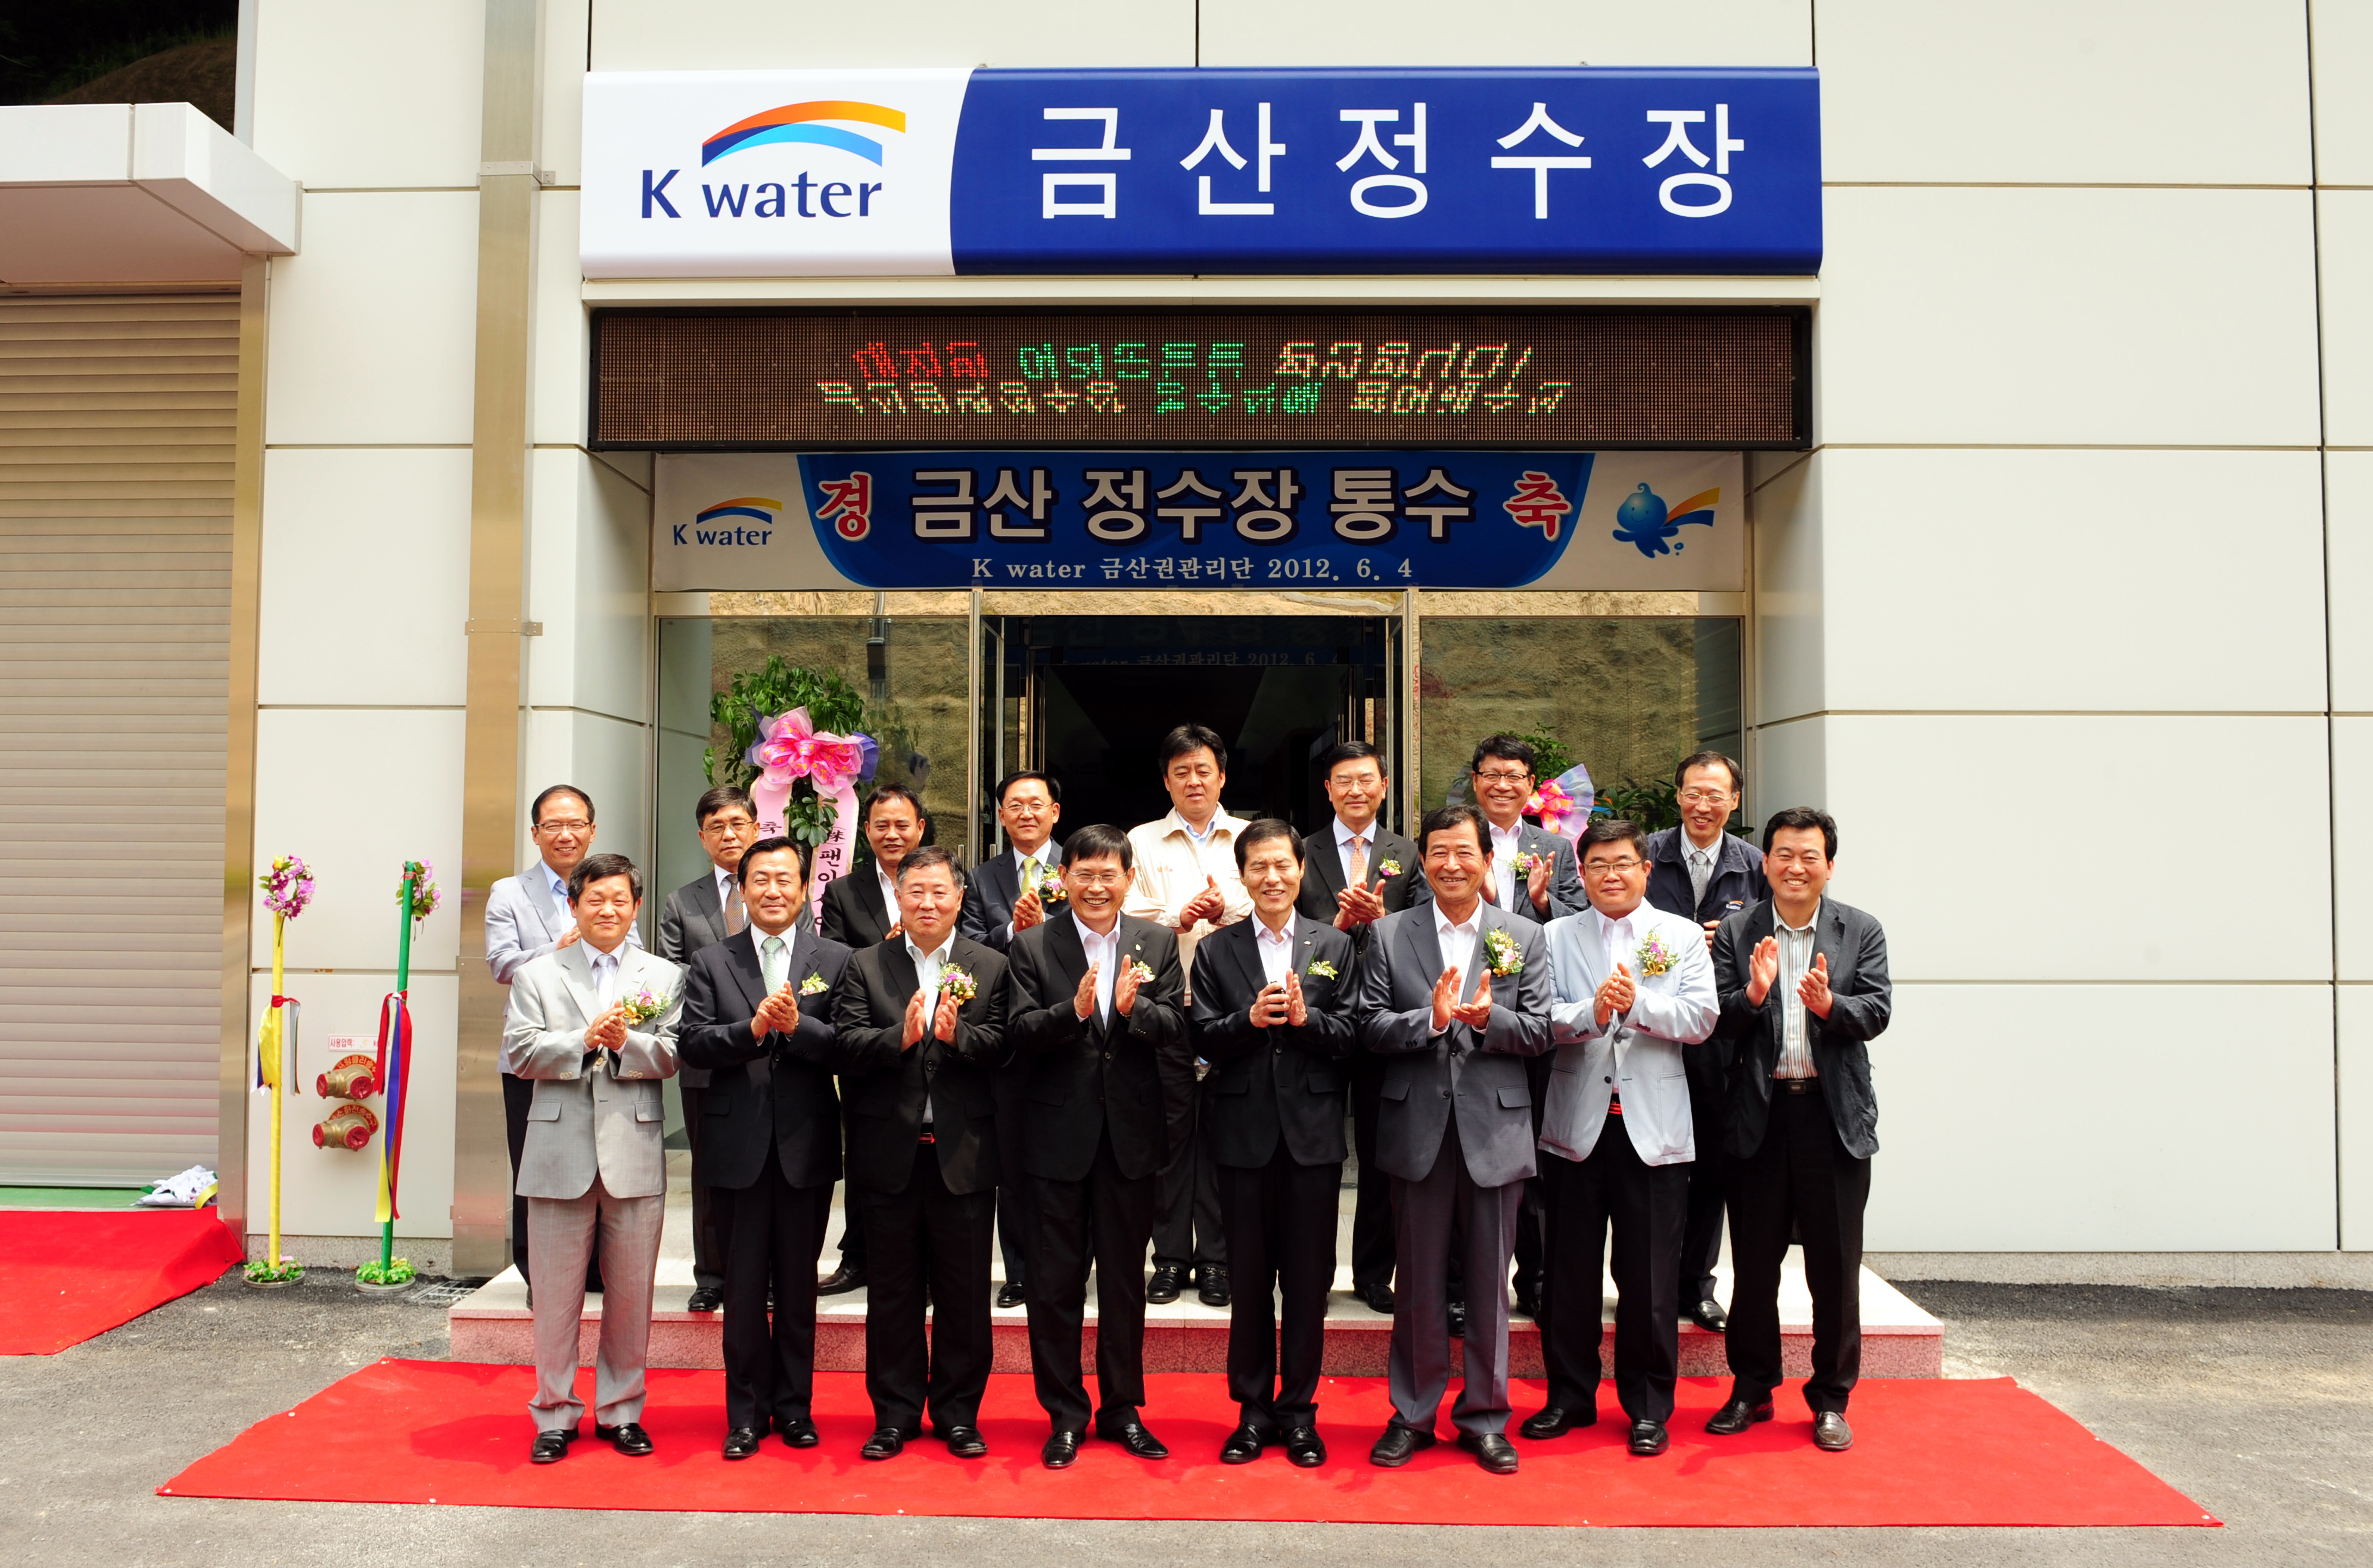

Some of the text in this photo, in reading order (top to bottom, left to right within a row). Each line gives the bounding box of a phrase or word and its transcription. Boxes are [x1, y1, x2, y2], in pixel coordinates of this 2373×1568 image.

[1032, 102, 1744, 219] 금산정수장
[642, 170, 882, 219] K water
[817, 469, 1572, 540] 경 금산 정수장 통수 축
[673, 524, 772, 546] K water
[972, 557, 1412, 581] K water 금산권관리단 2012. 6. 4
